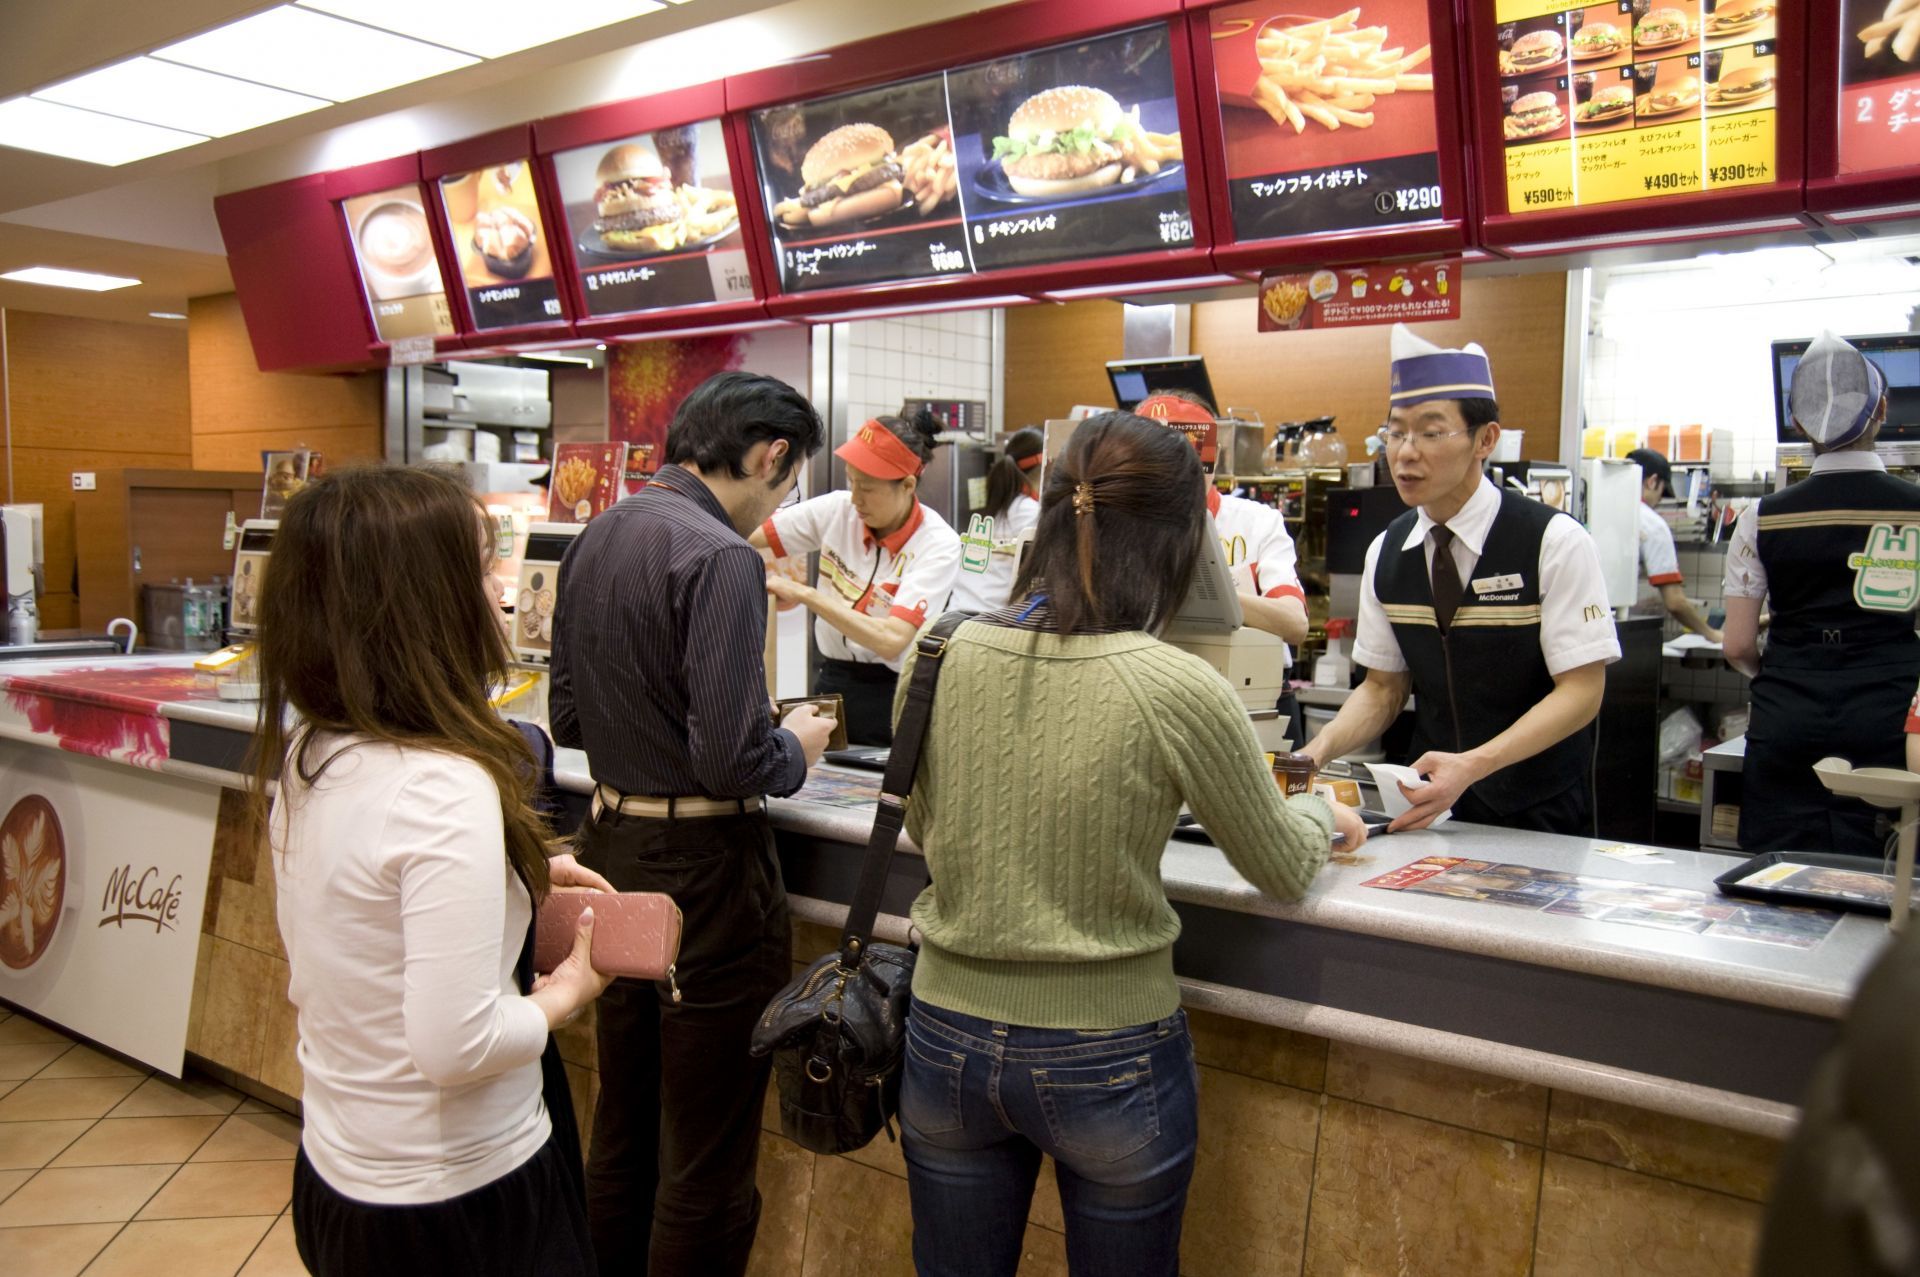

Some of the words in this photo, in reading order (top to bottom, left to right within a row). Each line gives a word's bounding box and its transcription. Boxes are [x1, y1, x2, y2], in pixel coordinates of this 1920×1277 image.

[1621, 3, 1627, 11] 6
[1557, 15, 1563, 24] 3
[1754, 45, 1767, 54] 19
[1688, 57, 1699, 66] 10
[1857, 96, 1873, 122] 2
[1709, 118, 1767, 132] チーズバーガー
[1639, 130, 1682, 143] えびフィレオ
[1709, 134, 1759, 147] ハンバーガー
[1581, 138, 1627, 151] チキンフィレオ
[1639, 143, 1697, 156] フィレオフィッシュ
[1581, 154, 1607, 164] てりやき
[1581, 160, 1627, 172] マックバーガー
[1250, 167, 1368, 198] マックフライポテト
[1396, 186, 1441, 212] ¥290
[1158, 210, 1180, 222] セット
[989, 214, 1057, 238] チキンフィレオ
[99, 864, 182, 934] McCafé
